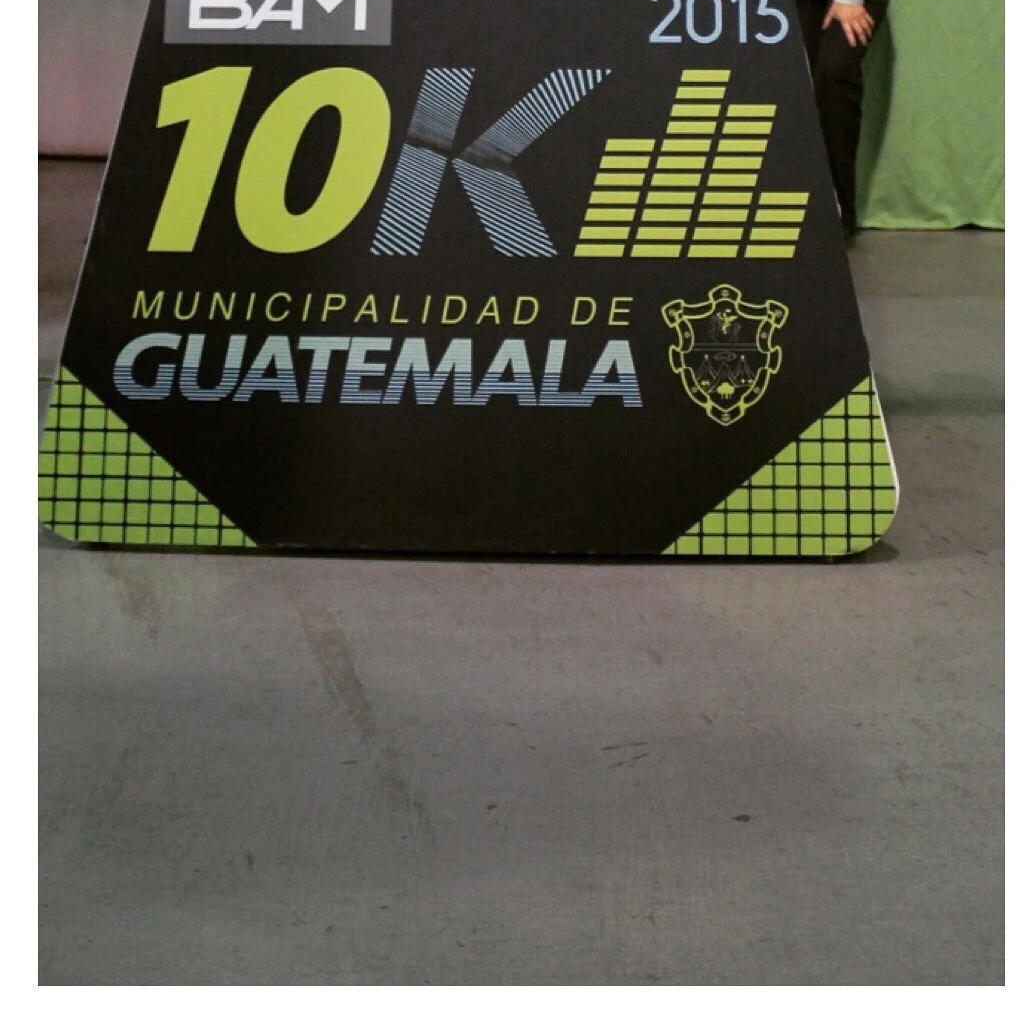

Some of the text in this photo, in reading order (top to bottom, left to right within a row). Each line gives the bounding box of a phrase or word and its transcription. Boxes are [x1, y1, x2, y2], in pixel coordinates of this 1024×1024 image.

[147, 66, 612, 256] 10K
[132, 290, 633, 326] MUNICIPALIDAD DE
[113, 332, 643, 407] GUATEMALA
